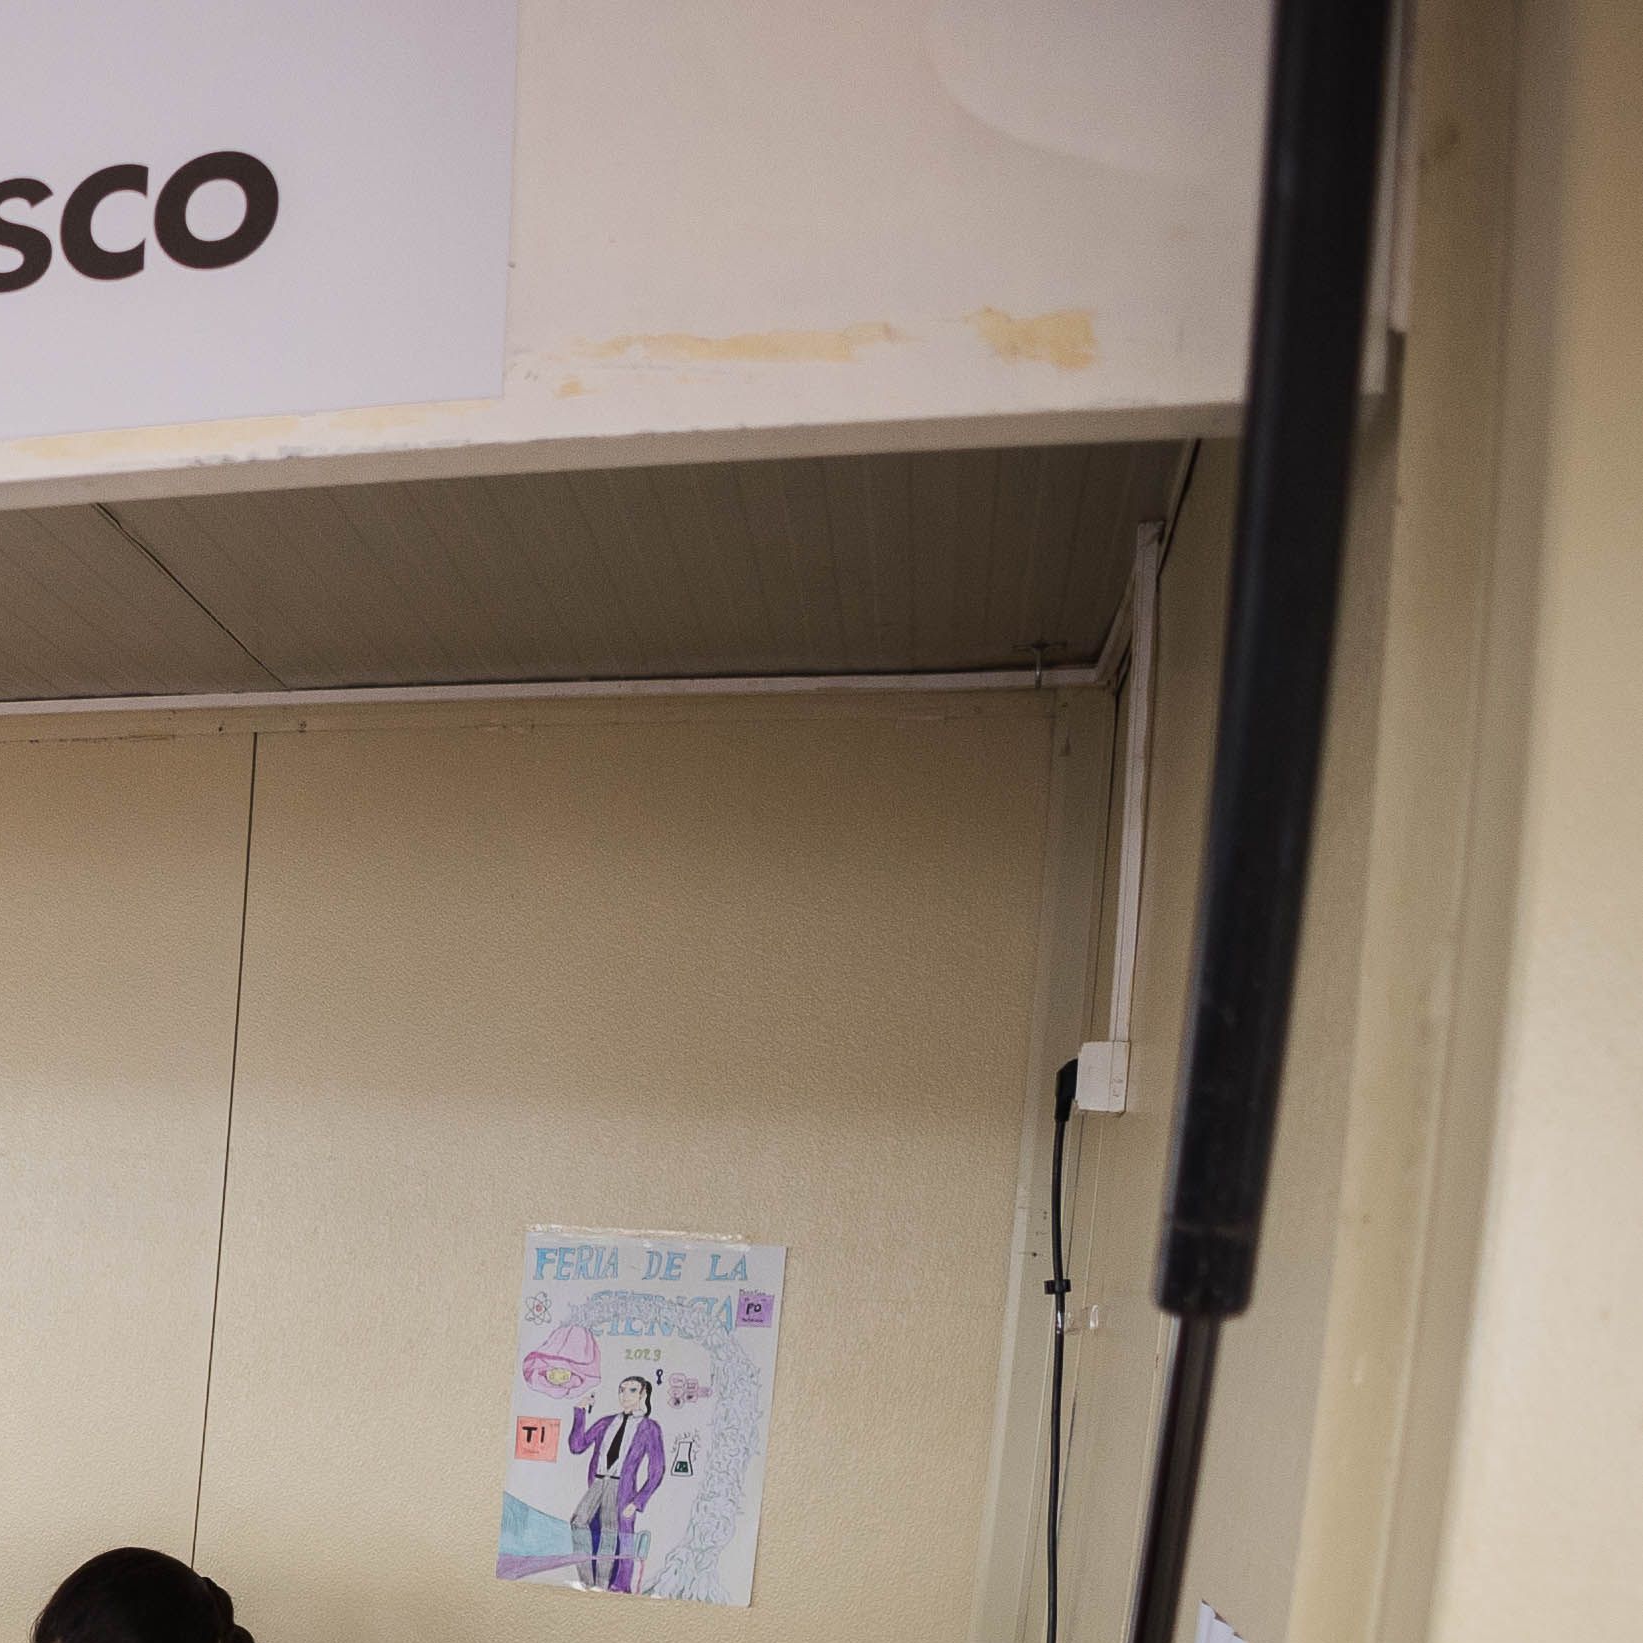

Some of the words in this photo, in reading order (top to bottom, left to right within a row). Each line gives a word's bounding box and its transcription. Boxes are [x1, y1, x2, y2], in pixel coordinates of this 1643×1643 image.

[533, 1245, 619, 1282] FERIA
[641, 1250, 687, 1281] DE
[706, 1254, 749, 1282] LA
